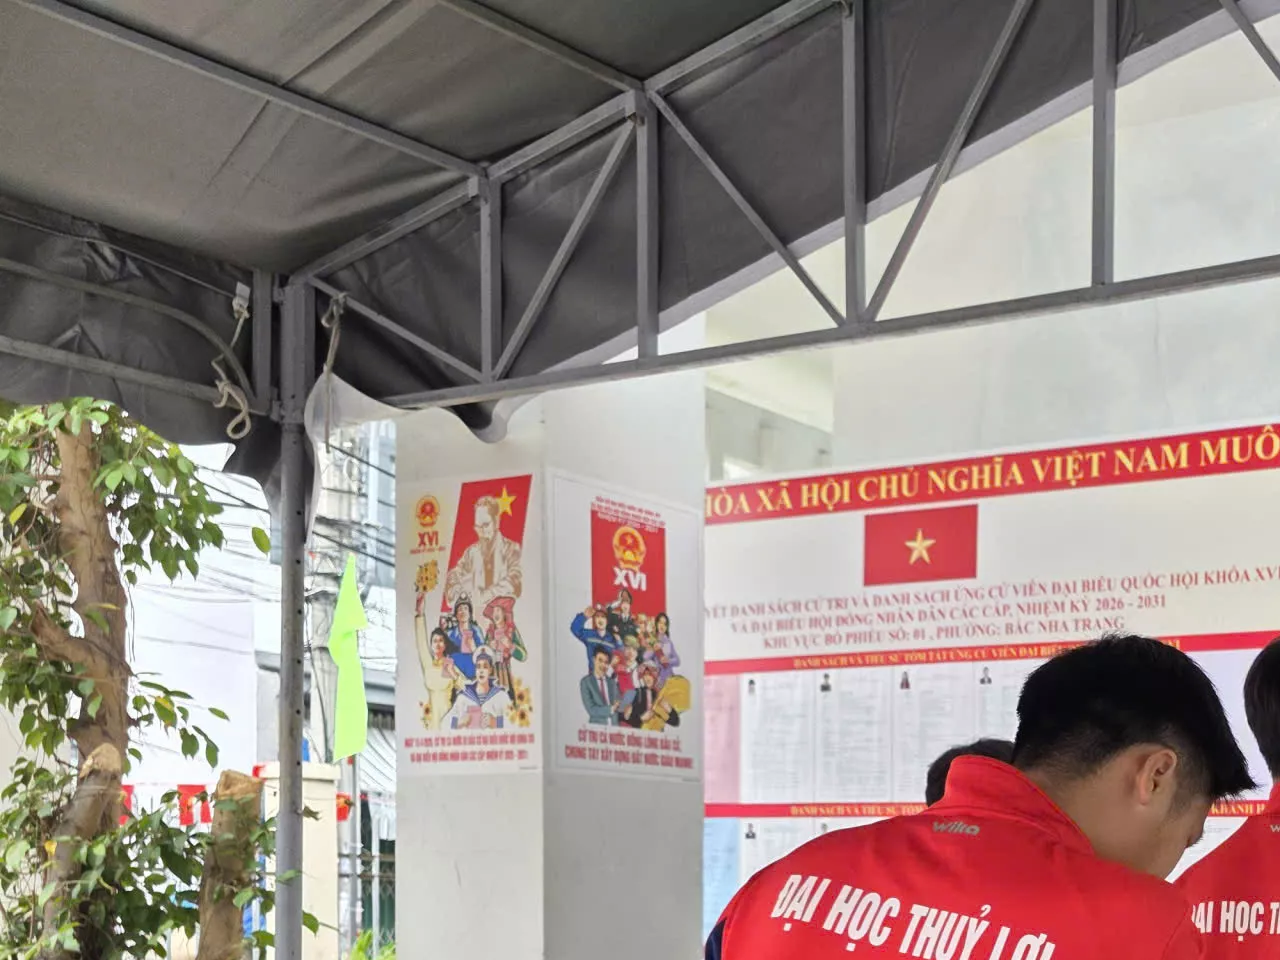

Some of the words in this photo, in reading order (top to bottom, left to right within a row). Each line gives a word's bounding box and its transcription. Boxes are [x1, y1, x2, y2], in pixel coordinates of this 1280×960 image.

[756, 481, 793, 513] XÃ
[801, 483, 851, 512] HỘI
[858, 466, 919, 502] CHỦ
[926, 455, 1025, 495] NGHĨA
[1032, 449, 1105, 487] VIỆT
[1114, 441, 1190, 476] NAM
[418, 531, 438, 547] XVI
[613, 566, 647, 591] XVI
[730, 602, 766, 617] DANH
[873, 593, 910, 607] DANH
[1013, 577, 1047, 597] VIÊN
[1082, 575, 1117, 593] BIỂU
[1121, 570, 1167, 593] QUỐC
[1170, 570, 1198, 590] HỘI
[1017, 597, 1066, 618] NHIỆM
[1095, 597, 1124, 611] 2026
[1137, 594, 1167, 610] 2031
[1038, 619, 1070, 634] NHA
[1072, 615, 1124, 632] TRANG
[770, 874, 831, 932] ĐẠI
[822, 884, 901, 952] HỌC
[1219, 900, 1264, 942] HỌC
